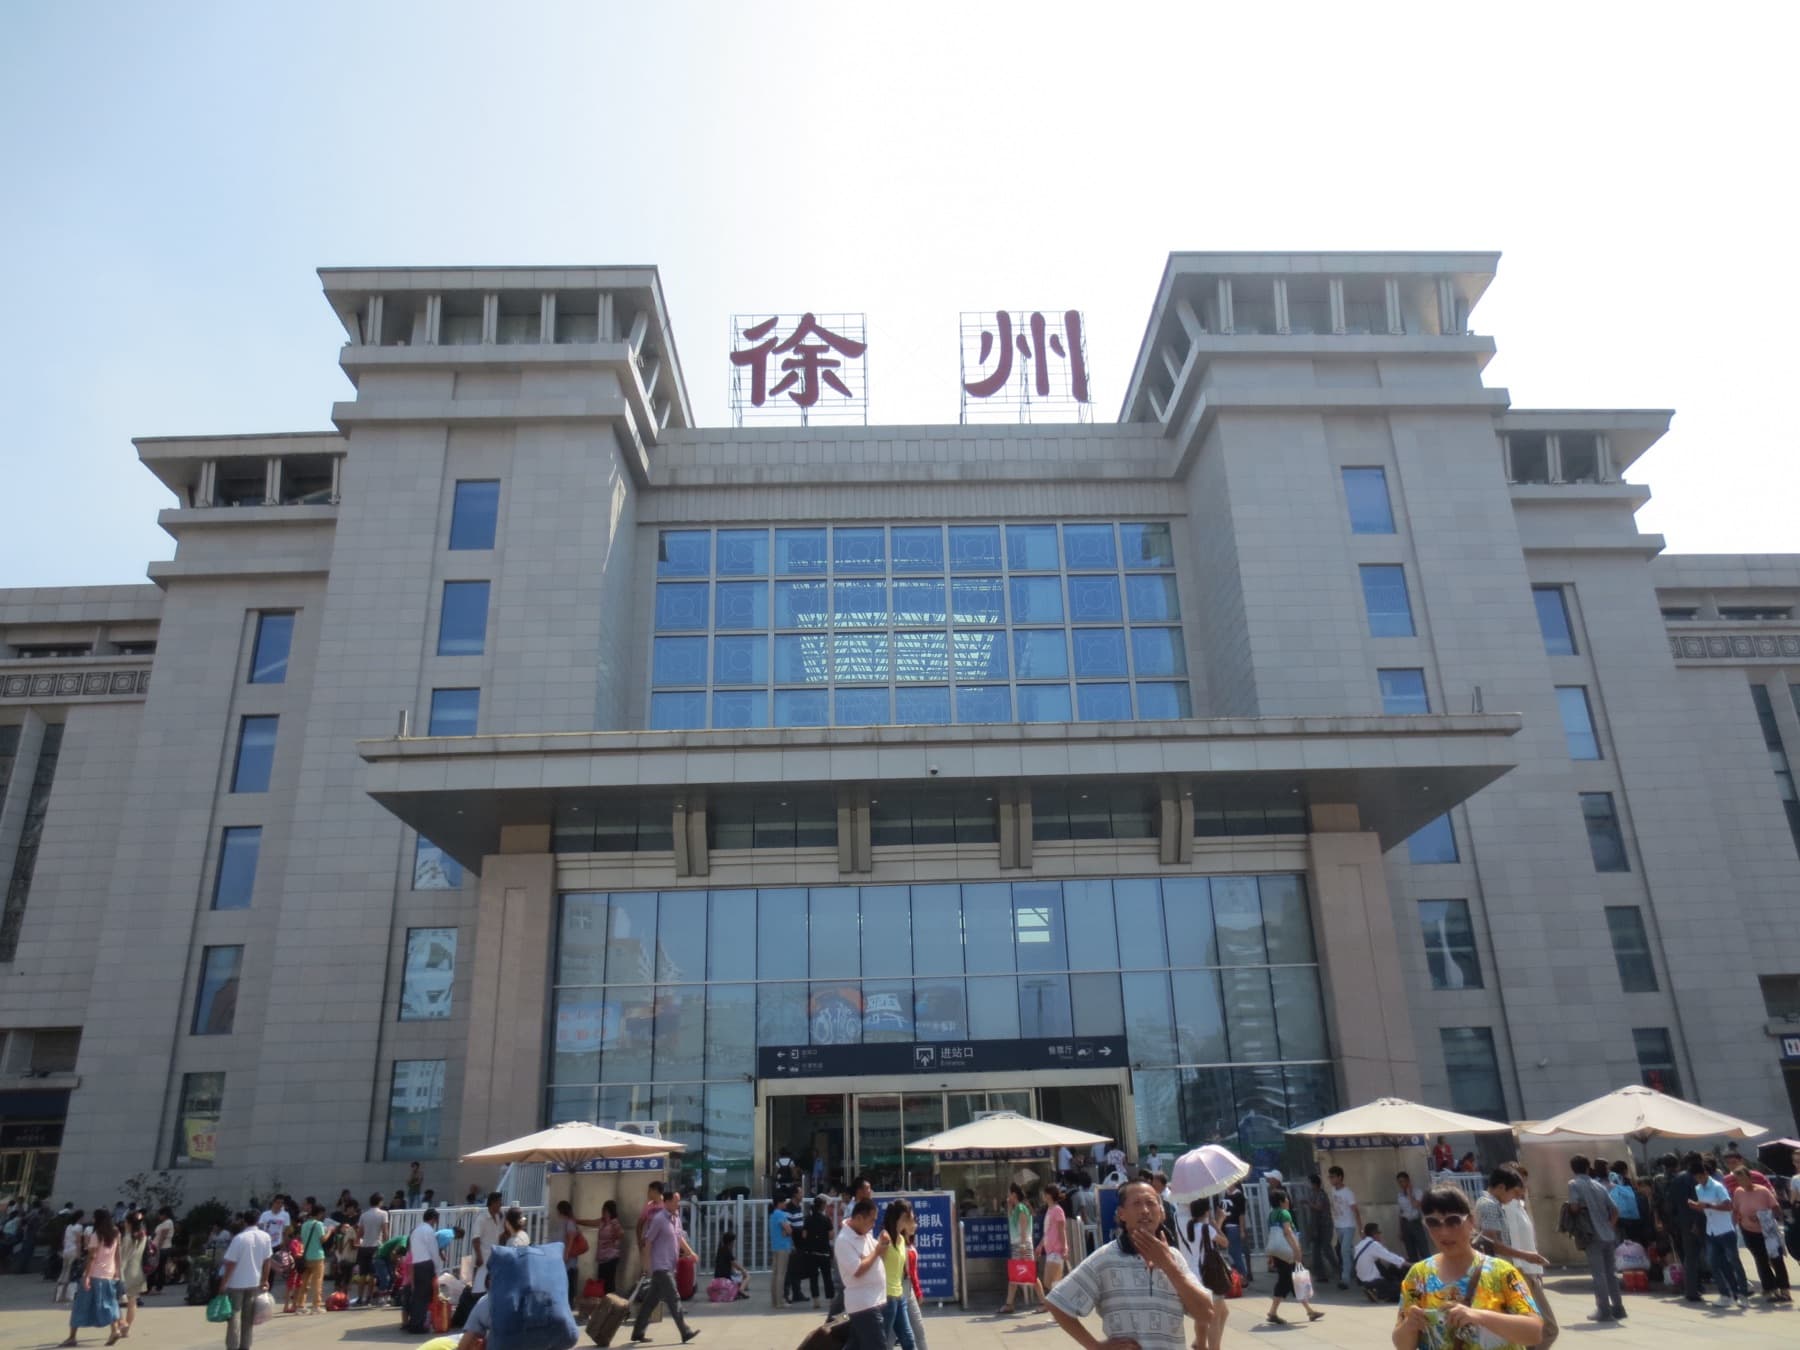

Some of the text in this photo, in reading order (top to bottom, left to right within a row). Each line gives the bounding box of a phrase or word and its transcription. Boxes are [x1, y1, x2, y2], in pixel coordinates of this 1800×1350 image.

[730, 309, 1089, 407] 徐州
[940, 1047, 974, 1059] 进站口
[571, 1159, 645, 1171] 名制验证处
